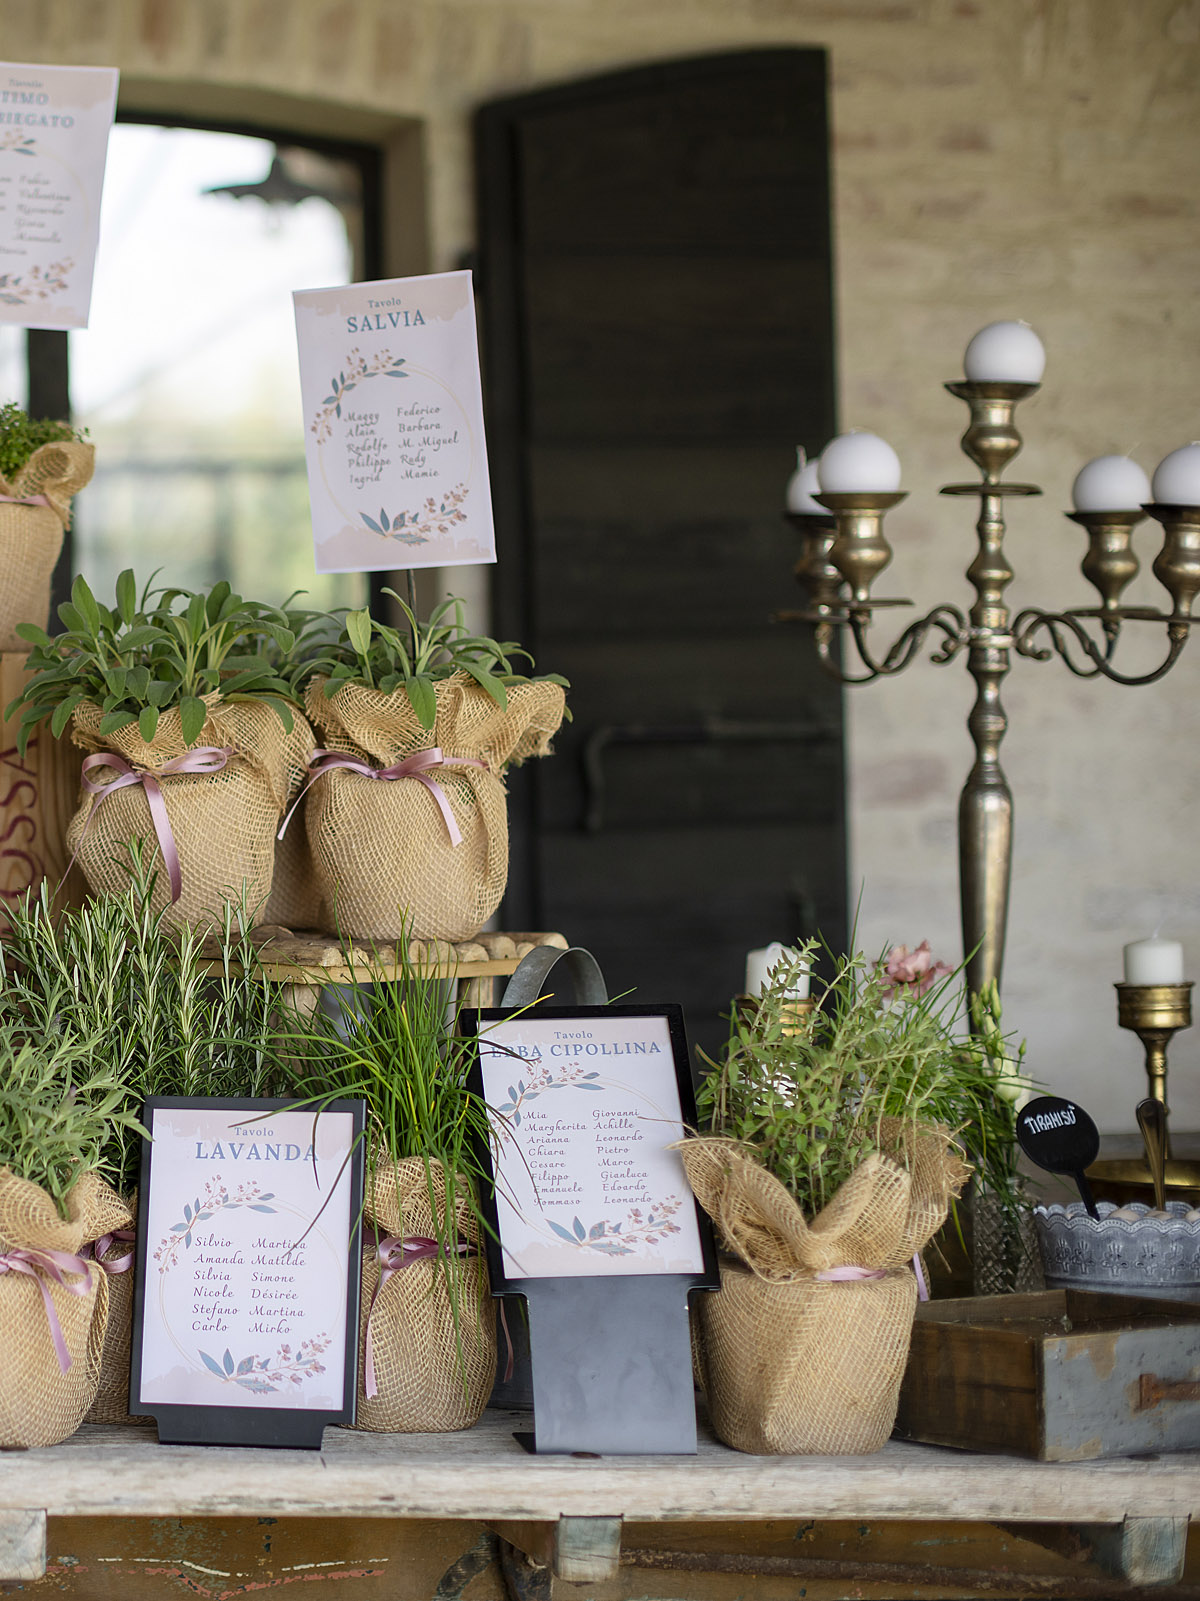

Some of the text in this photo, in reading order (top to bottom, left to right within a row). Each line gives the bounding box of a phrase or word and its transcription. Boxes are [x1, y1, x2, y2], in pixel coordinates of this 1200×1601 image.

[1, 90, 49, 105] TIMO
[368, 297, 402, 309] Tavolo
[346, 309, 426, 334] SALVIA
[397, 402, 441, 418] Federico
[346, 425, 376, 438] Alain
[398, 418, 441, 433] Barbara
[346, 437, 388, 456] Rodolfo
[418, 431, 460, 452] Miguel
[348, 453, 391, 474] Philippe
[350, 472, 382, 490] Ingrid
[554, 1031, 593, 1039] Tavolo
[550, 1041, 661, 1057] CIPOLLINA
[523, 1111, 547, 1120] Mia
[592, 1109, 639, 1121] Giovanni
[524, 1121, 588, 1136] Margherita
[593, 1119, 635, 1130] Achille
[234, 1127, 274, 1137] Tavolo
[595, 1131, 644, 1142] Leonardo
[526, 1135, 570, 1144] Arianna
[195, 1142, 318, 1161] LAVANDA
[528, 1147, 565, 1157] Chiara
[597, 1145, 630, 1155] Pietro
[530, 1160, 566, 1169] Cesare
[598, 1158, 635, 1167] Marco
[531, 1171, 570, 1187] Filippo
[600, 1170, 649, 1182] Gianluca
[533, 1184, 584, 1194] Emanuele
[603, 1182, 648, 1192] Edoardo
[533, 1198, 582, 1207] Tommaso
[603, 1194, 653, 1204] Leonardo
[195, 1234, 233, 1248] Silvio
[251, 1238, 308, 1250] Martina
[193, 1250, 245, 1265] Amanda
[251, 1253, 307, 1266] Matilde
[193, 1267, 232, 1281] Silvia
[251, 1271, 295, 1283] Simone
[193, 1285, 234, 1298] Nicole
[250, 1289, 299, 1300] Désirée
[192, 1302, 240, 1321] Stefano
[249, 1306, 306, 1317] Martina
[191, 1319, 229, 1332] Carlo
[249, 1319, 292, 1334] Mirko
